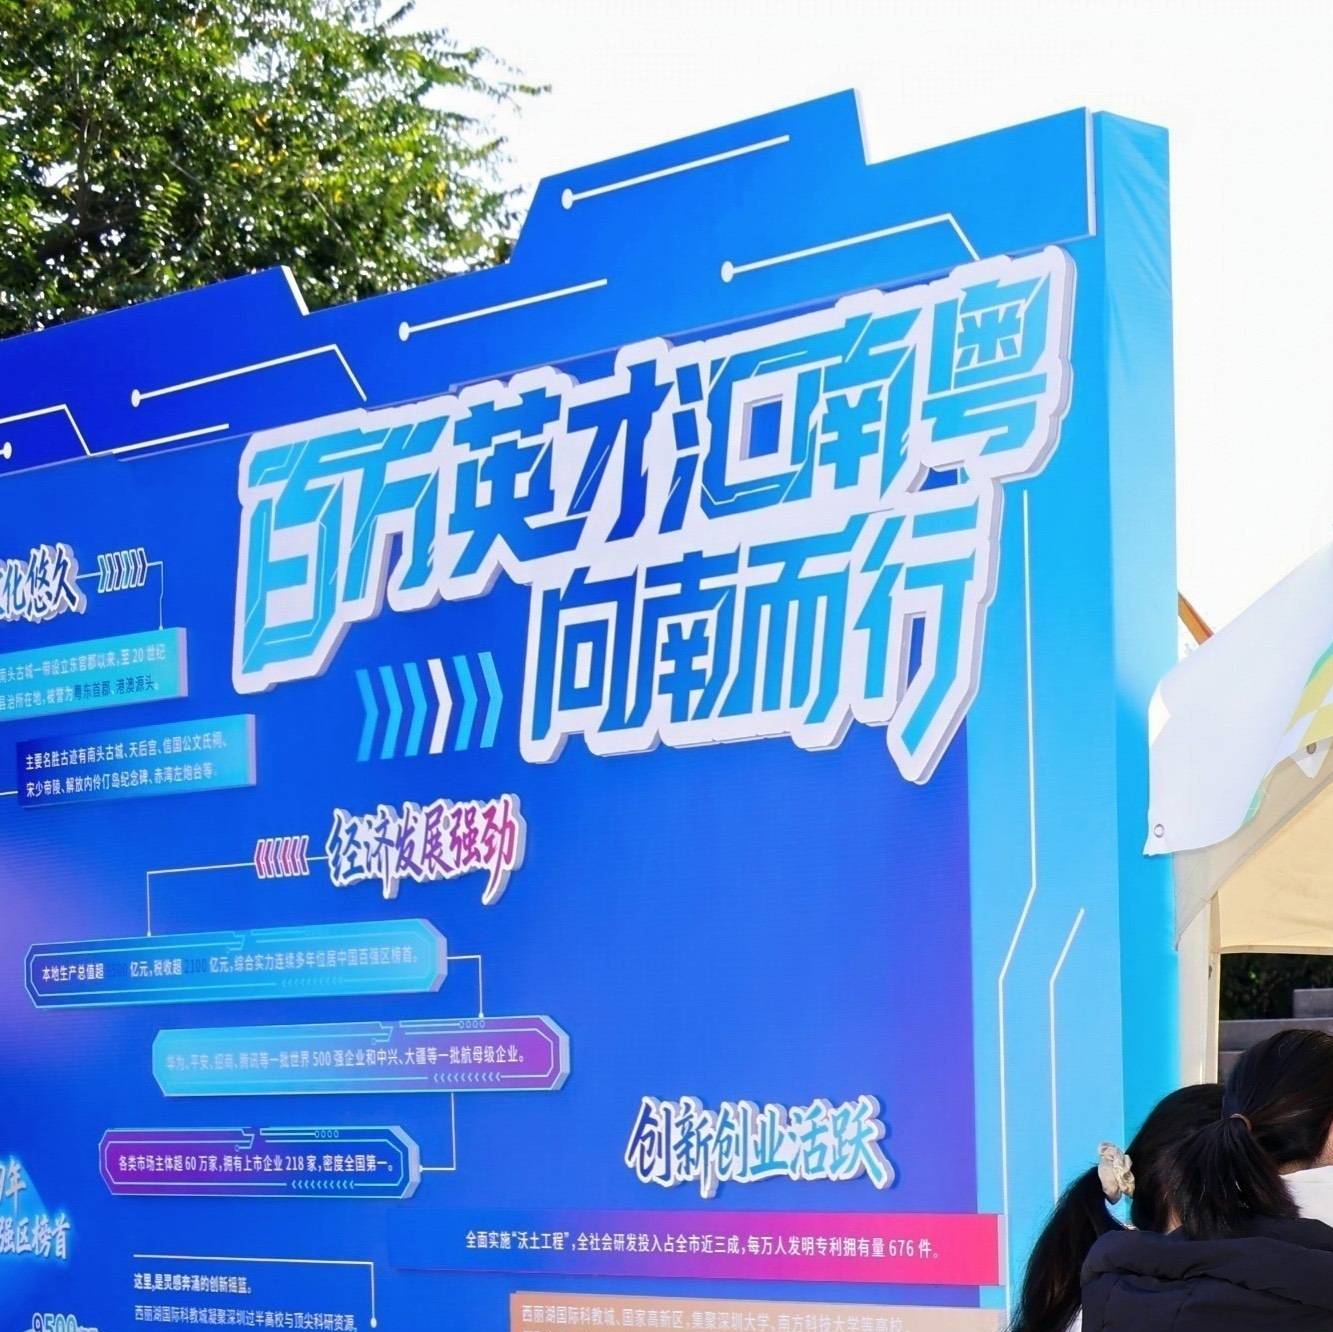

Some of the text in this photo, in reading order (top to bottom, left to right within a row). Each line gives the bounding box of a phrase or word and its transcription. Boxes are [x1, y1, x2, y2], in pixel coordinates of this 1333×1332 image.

[233, 246, 1076, 693] 百万英才汇南粤
[0, 543, 86, 623] 化悠久
[521, 478, 1001, 785] 向南而行
[327, 794, 526, 905] 经济发展强劲
[625, 1095, 896, 1198] 创新创业活跃
